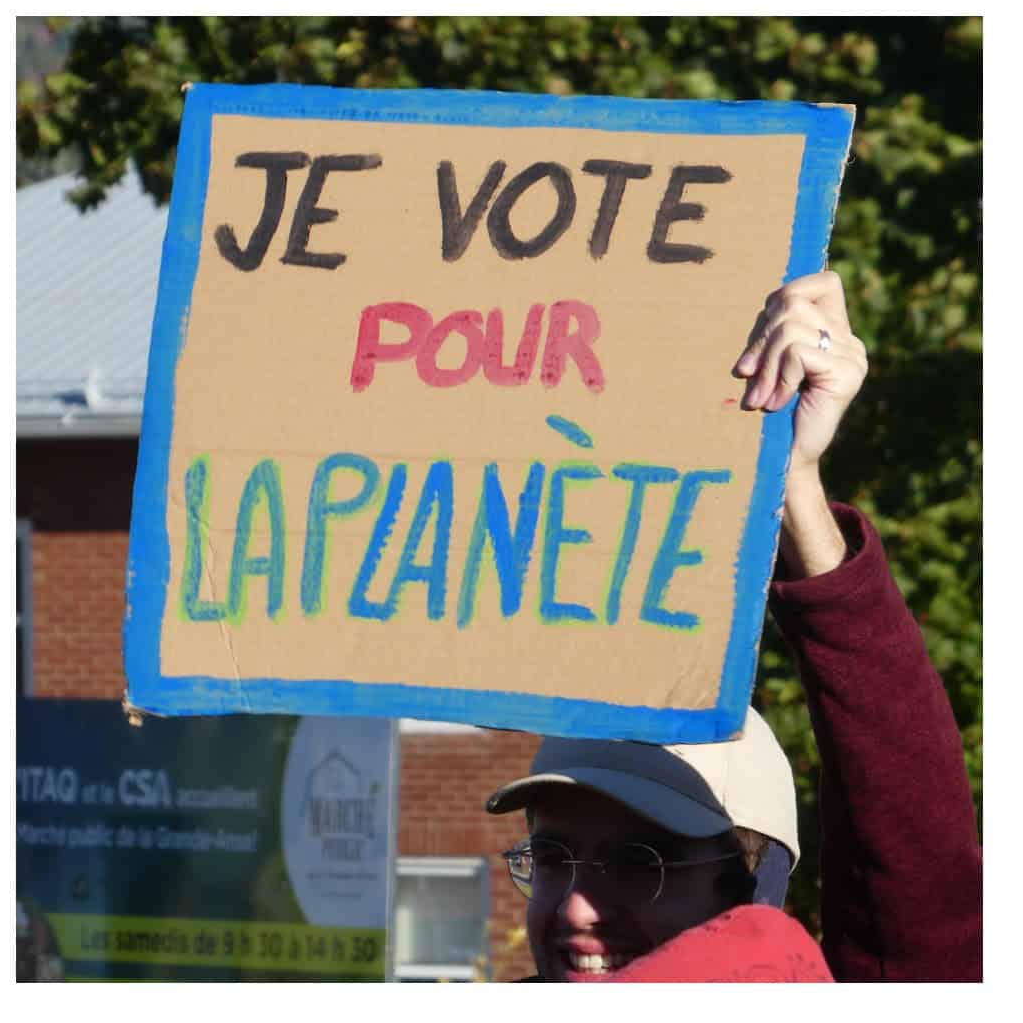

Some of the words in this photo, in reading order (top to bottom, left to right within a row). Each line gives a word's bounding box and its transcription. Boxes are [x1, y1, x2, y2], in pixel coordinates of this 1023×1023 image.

[214, 151, 383, 272] JE
[436, 159, 735, 263] VOTE
[350, 299, 606, 394] POUR
